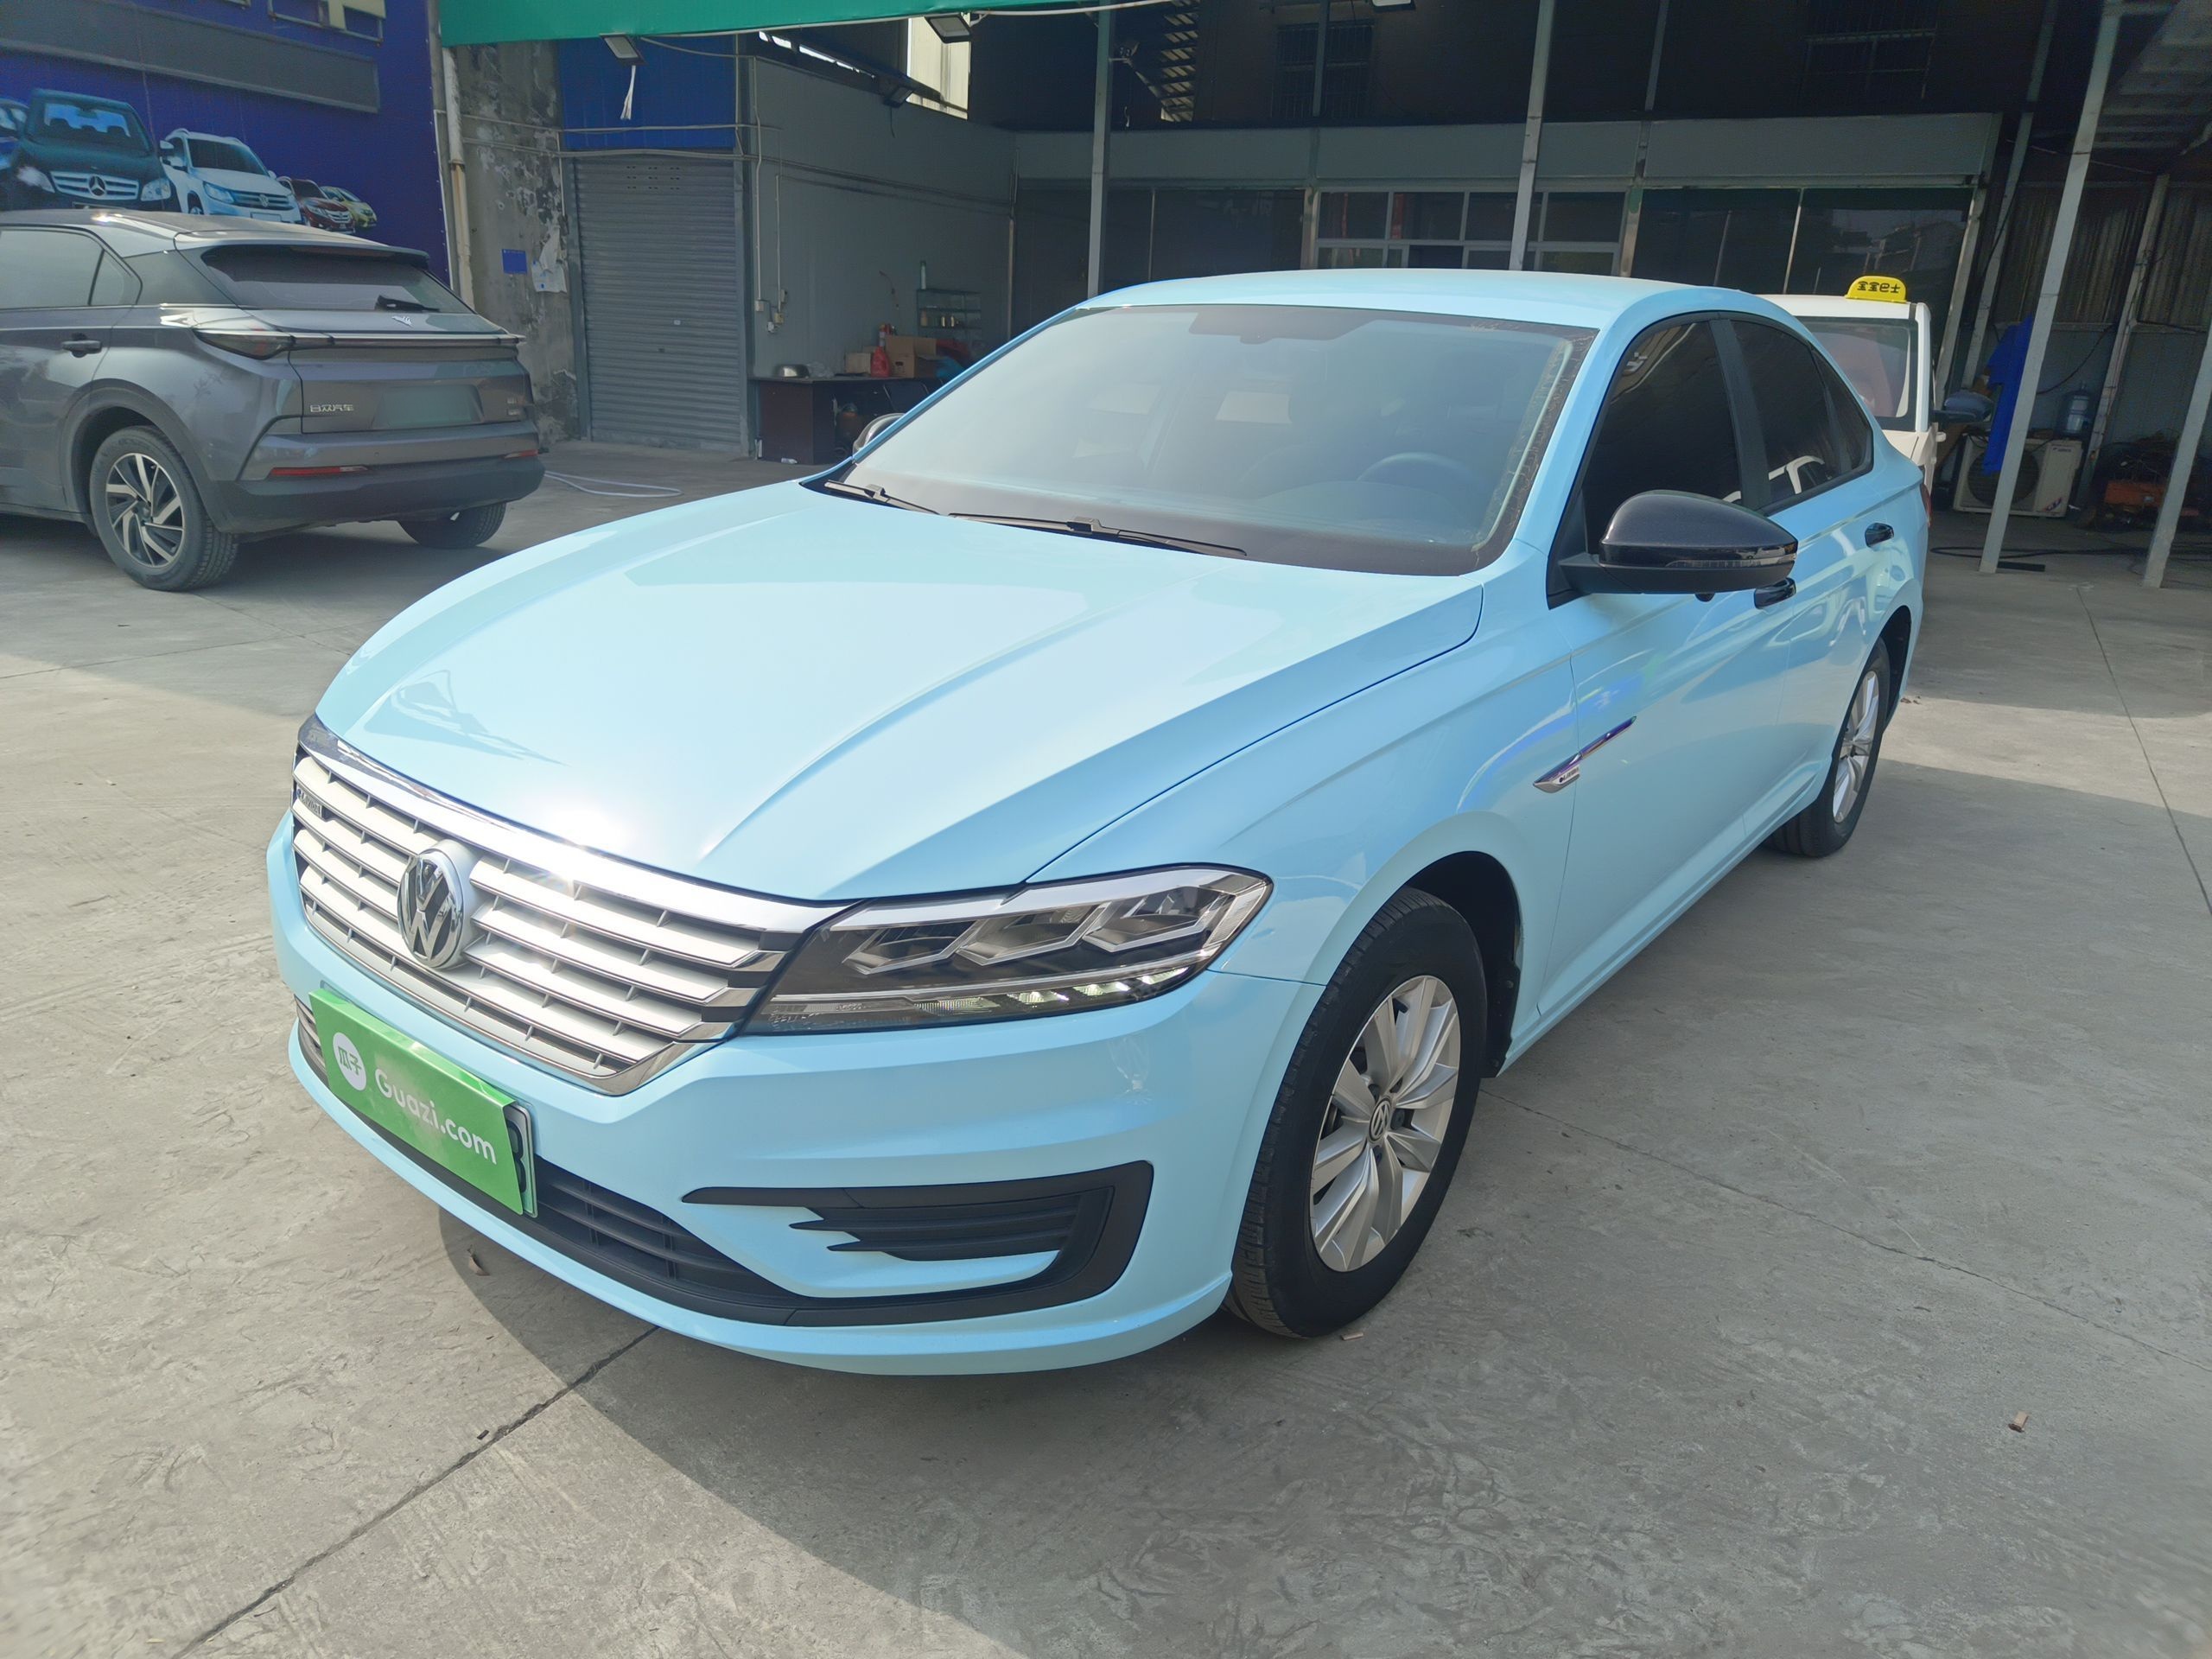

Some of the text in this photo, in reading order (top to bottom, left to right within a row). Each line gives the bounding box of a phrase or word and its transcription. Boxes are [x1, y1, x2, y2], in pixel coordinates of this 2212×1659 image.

[1857, 281, 1901, 293] 宝宝巴士
[338, 1048, 362, 1077] 瓜子
[375, 1069, 498, 1165] Guazi.com
